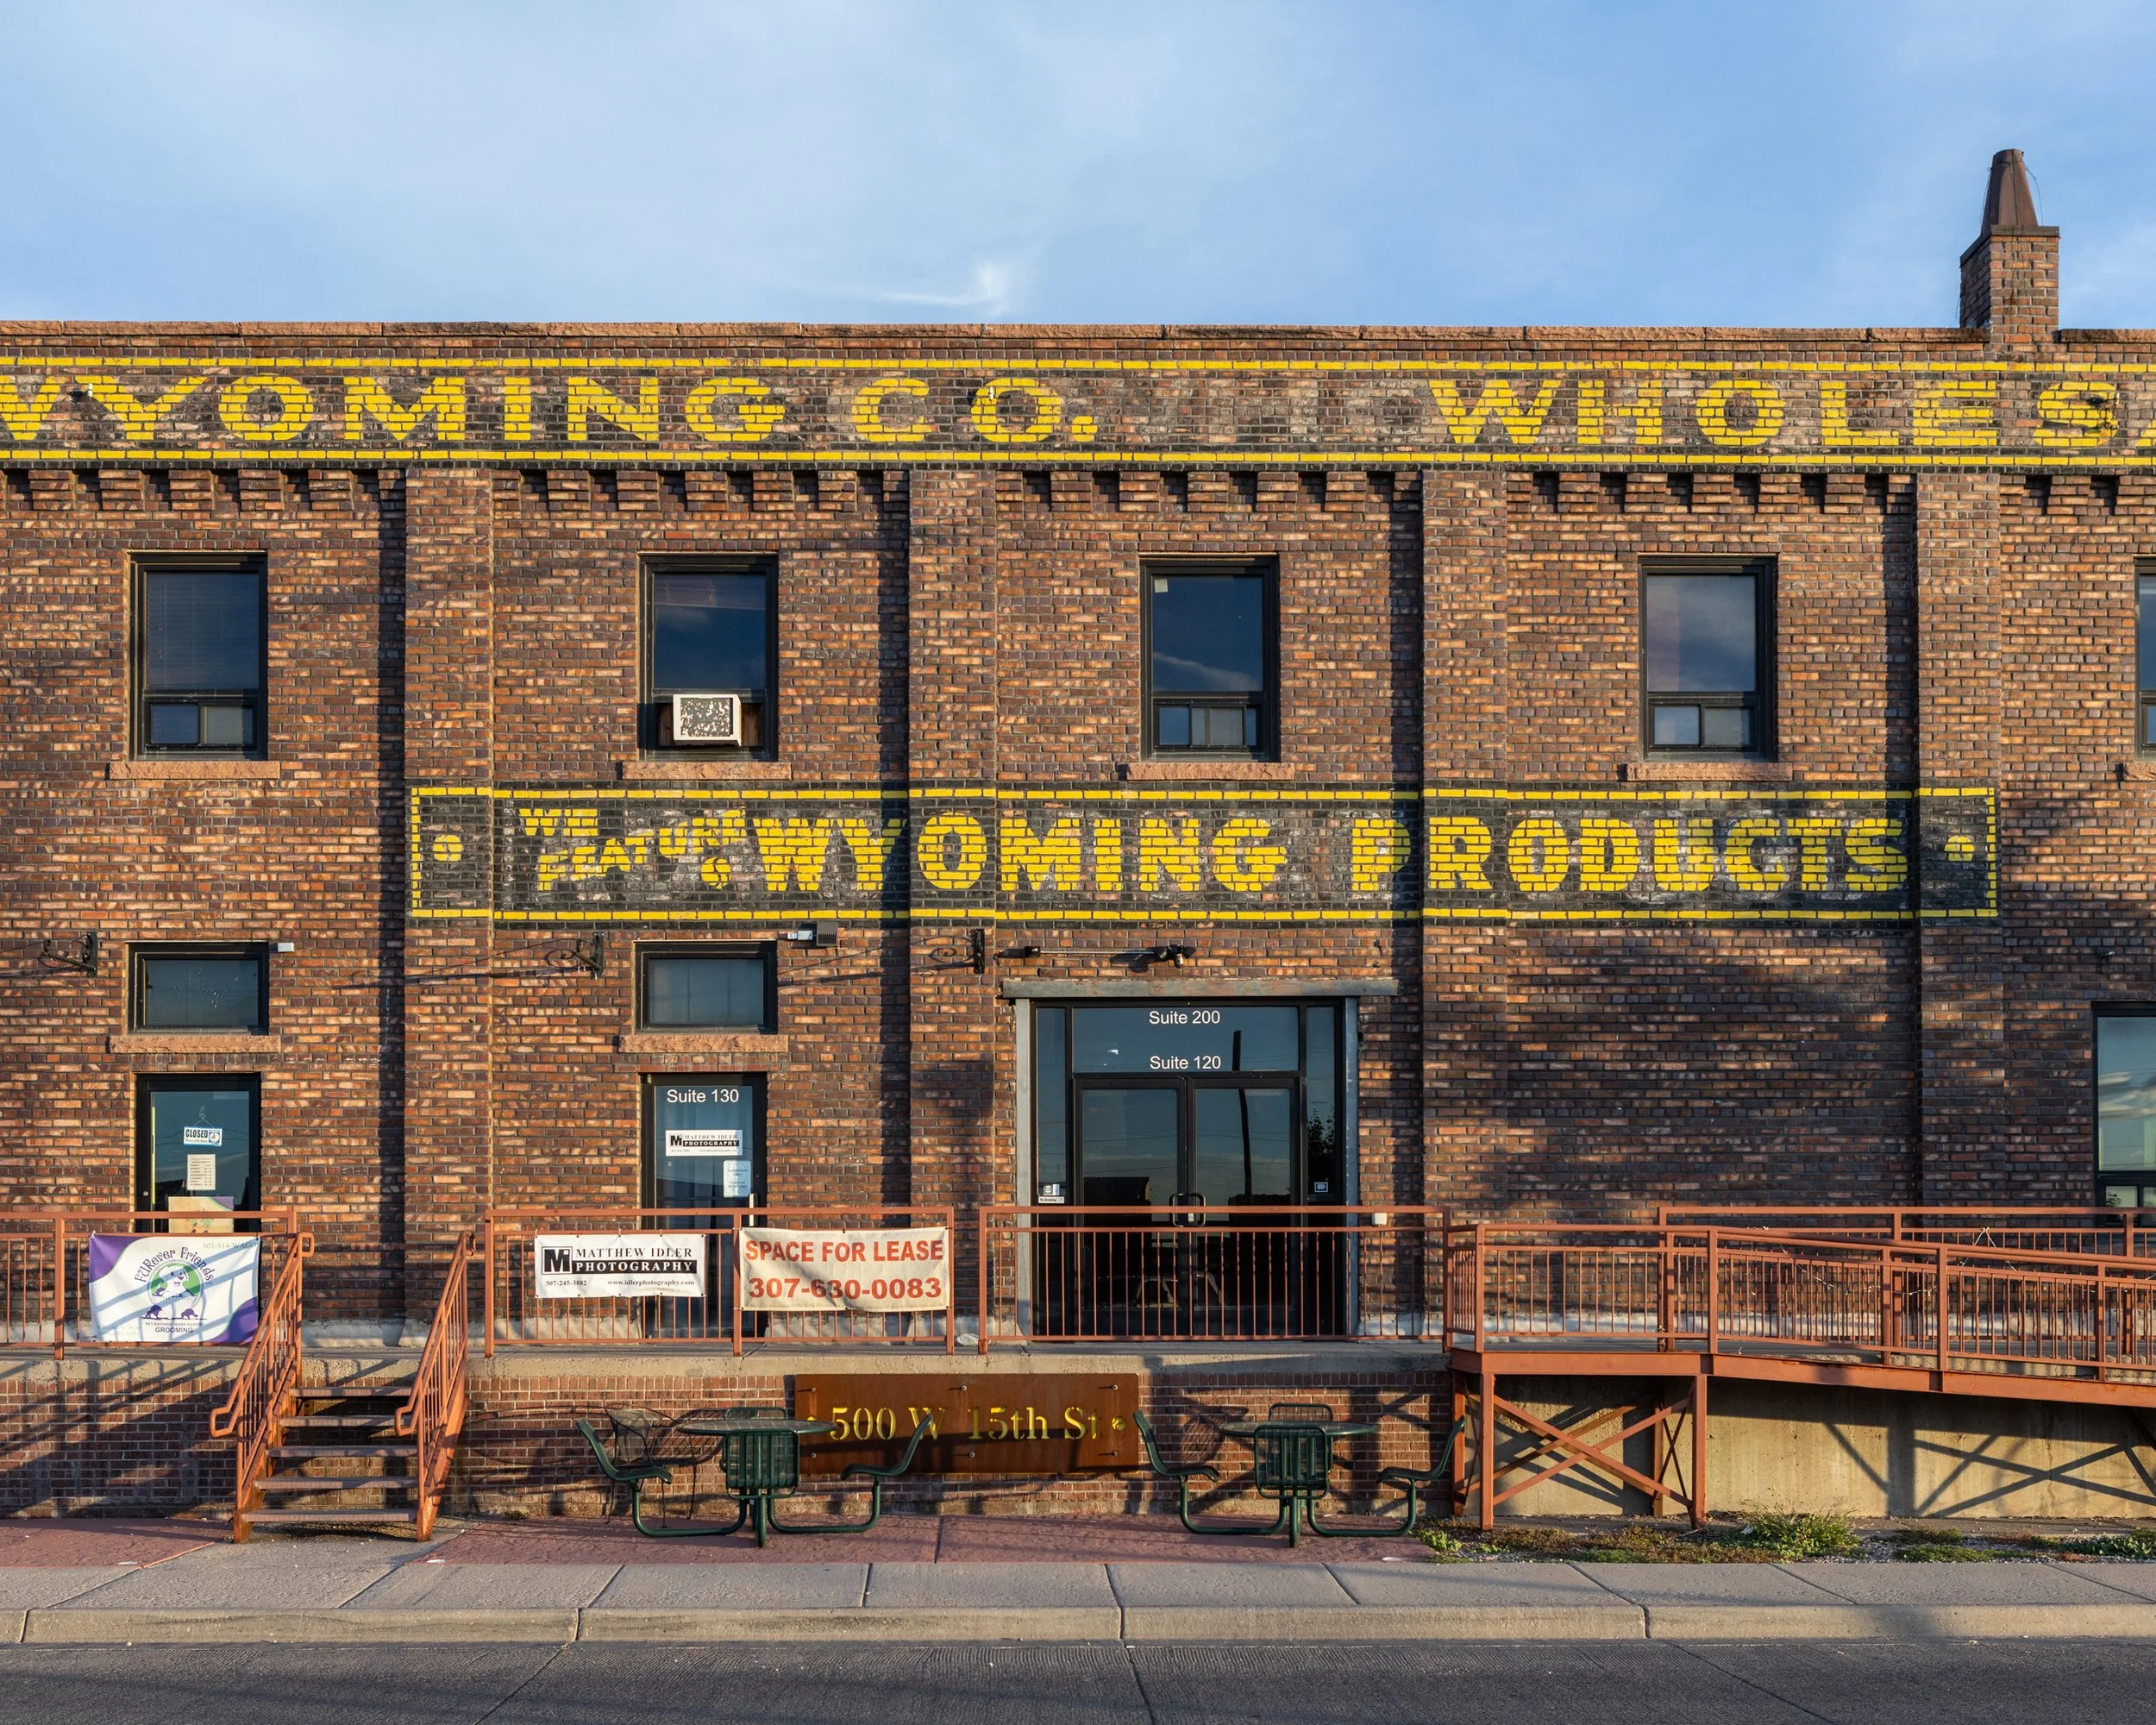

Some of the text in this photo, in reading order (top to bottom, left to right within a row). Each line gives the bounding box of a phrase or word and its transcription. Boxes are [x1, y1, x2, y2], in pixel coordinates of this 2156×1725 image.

[851, 377, 1098, 443] CO.
[1428, 378, 2156, 448] WHOLES
[518, 807, 599, 837] WE
[754, 811, 1908, 894] WYOMING PRODUCTS
[1149, 1010, 1220, 1025] Suite 200
[1150, 1055, 1221, 1070] Suite 120
[667, 1088, 739, 1103] Suite 130
[185, 1129, 209, 1138] CLOSED
[576, 1247, 693, 1258] MATTHEW IDLER
[745, 1239, 943, 1263] SPACE FOR LEASE
[180, 1246, 216, 1281] Friends
[575, 1261, 693, 1271] PHOTOGRAPHY
[749, 1277, 942, 1300] 307-630-0083
[830, 1407, 1099, 1440] 500 W 15th St
